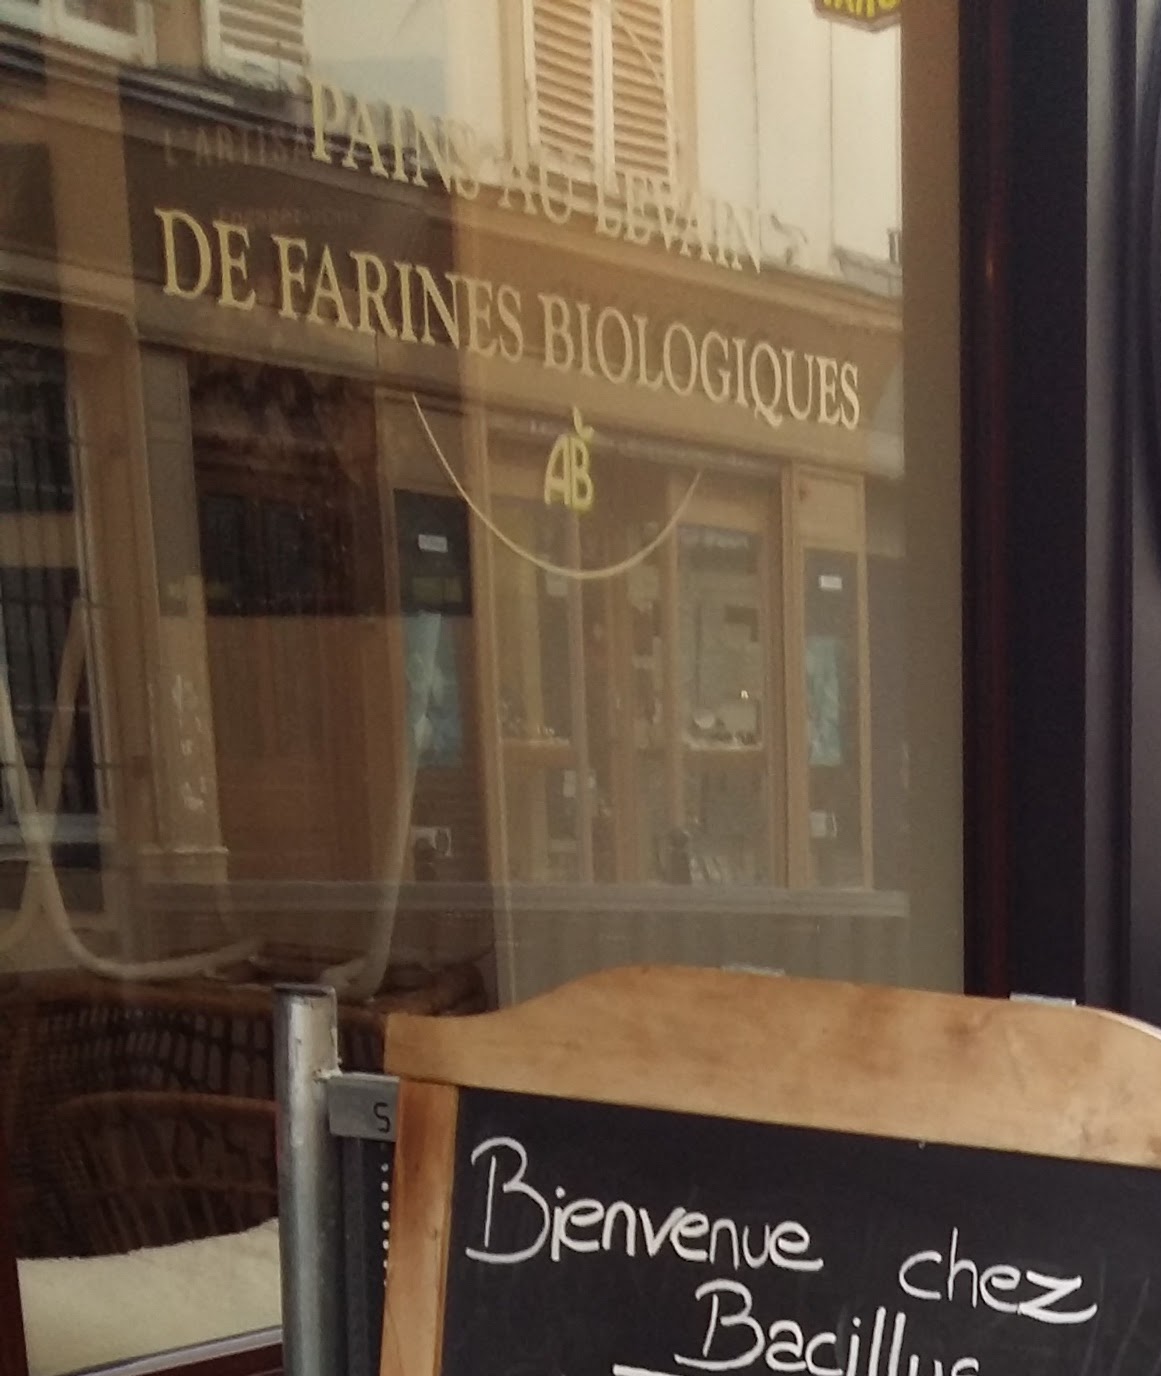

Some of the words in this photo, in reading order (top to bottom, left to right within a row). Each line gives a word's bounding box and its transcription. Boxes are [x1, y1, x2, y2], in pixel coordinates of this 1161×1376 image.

[303, 77, 480, 200] PAINS
[499, 135, 575, 225] AU
[596, 157, 764, 274] LEVAIN
[154, 207, 256, 311] DE
[271, 233, 524, 363] FARINES
[537, 292, 862, 431] BIOLOGIQUES
[465, 1137, 823, 1271] Bienvenue
[899, 1227, 1097, 1324] chez
